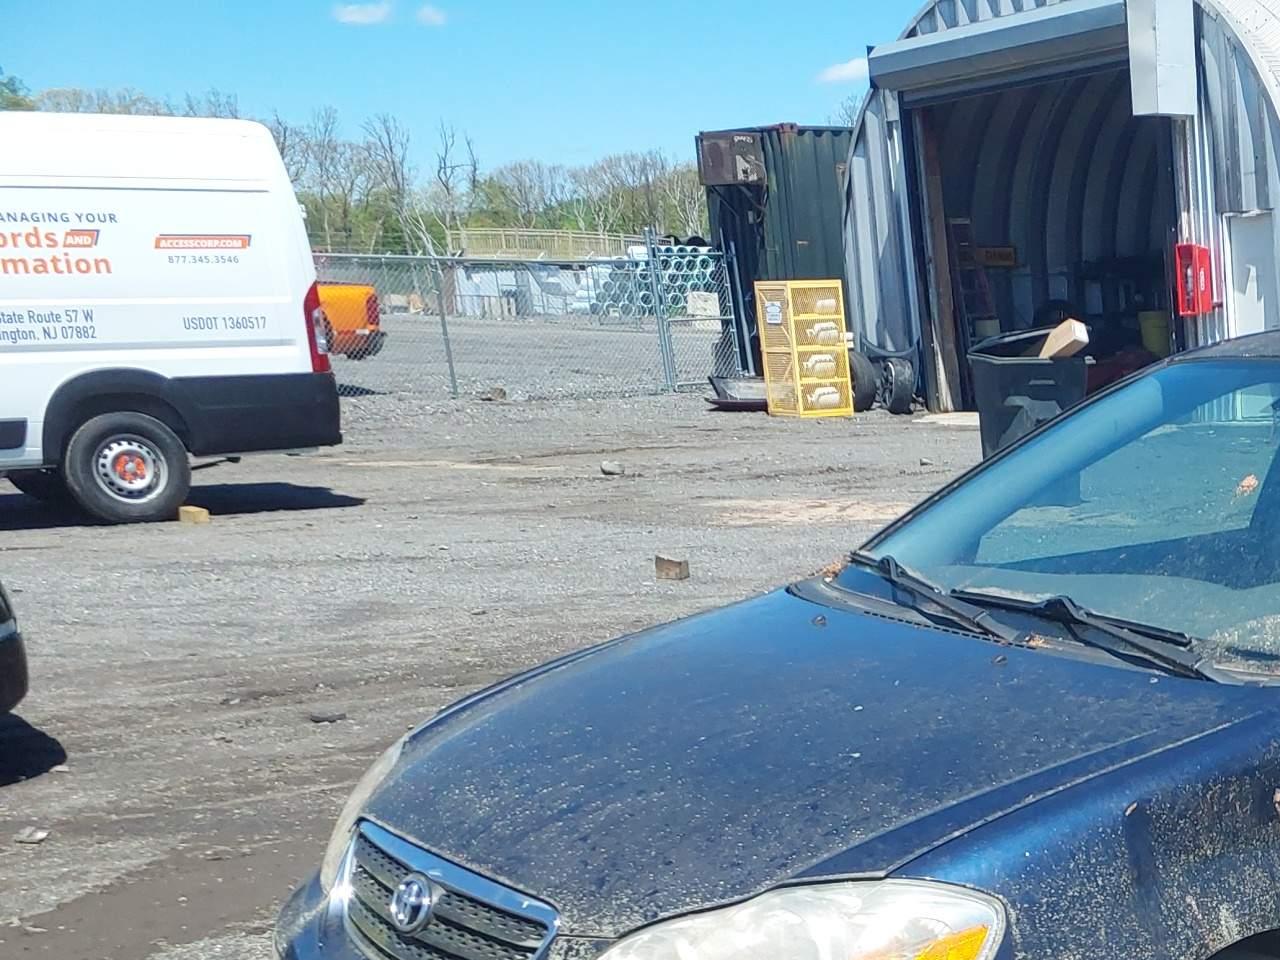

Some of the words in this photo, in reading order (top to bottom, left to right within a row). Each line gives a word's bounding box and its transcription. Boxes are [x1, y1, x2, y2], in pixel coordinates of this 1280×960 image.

[75, 213, 118, 223] YOUR
[65, 235, 92, 245] AND
[160, 239, 241, 248] ACCESSCORP.COM
[0, 252, 112, 274] mation
[168, 255, 239, 264] 877.345.3546
[27, 310, 62, 324] Route
[65, 309, 78, 323] 57
[82, 309, 94, 323] W
[183, 317, 218, 330] USDOT
[222, 316, 266, 329] 1360517
[42, 326, 58, 339] NJ
[61, 325, 96, 339] 07882
